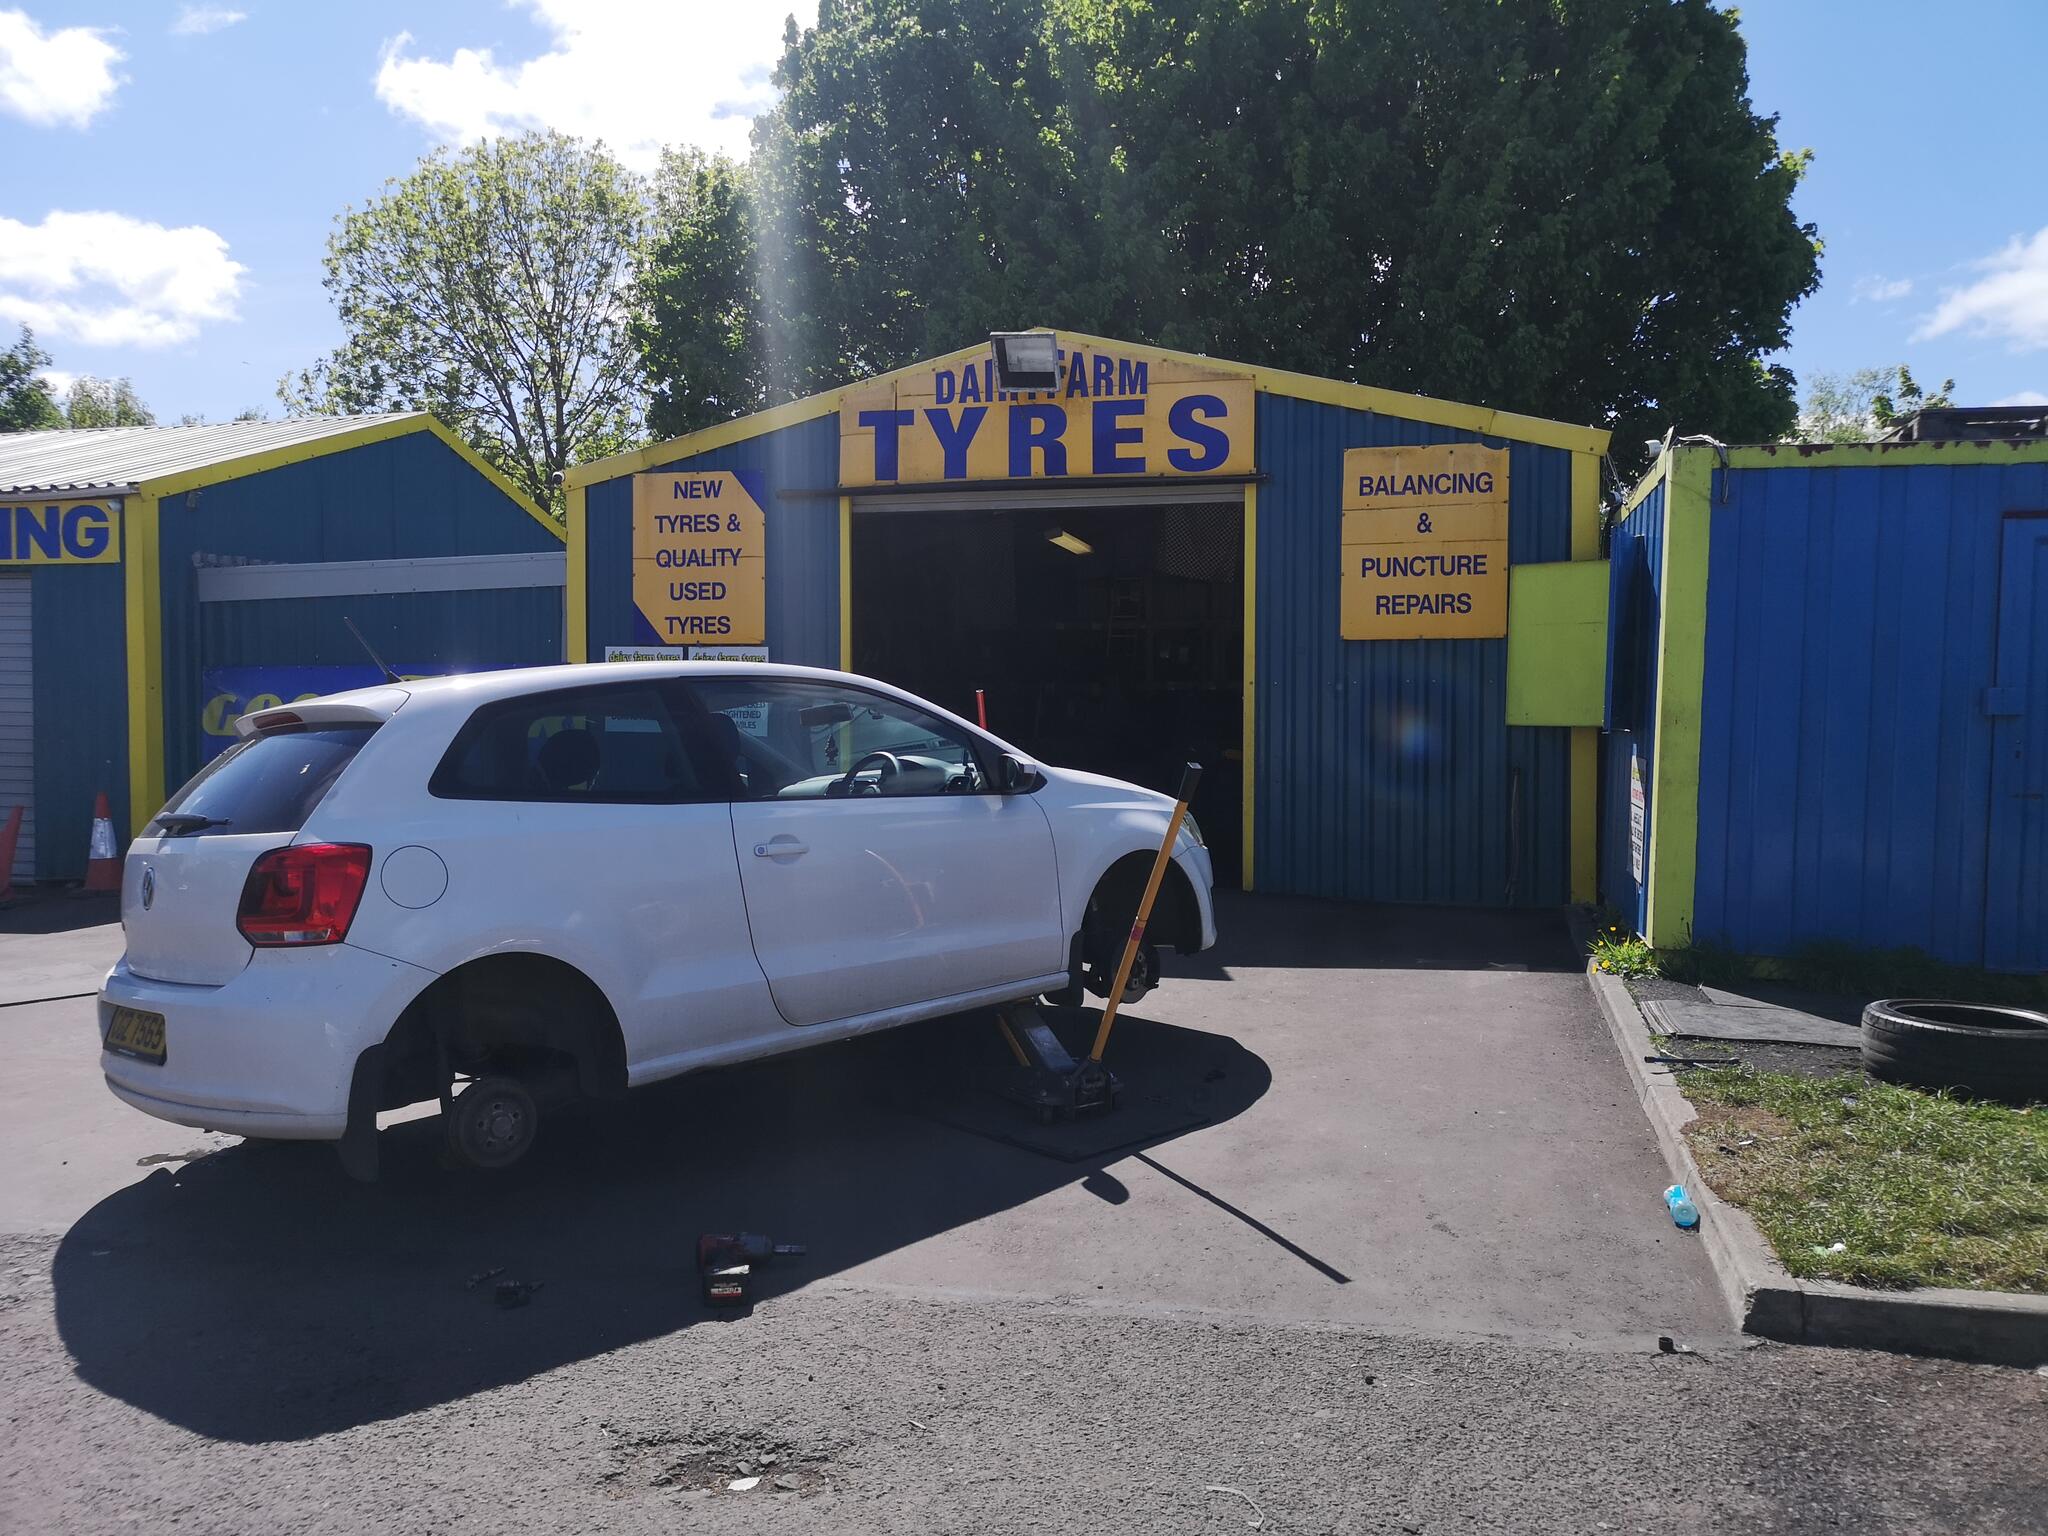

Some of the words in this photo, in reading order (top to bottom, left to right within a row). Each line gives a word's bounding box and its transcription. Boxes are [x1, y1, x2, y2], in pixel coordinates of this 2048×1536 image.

[936, 358, 1036, 405] DAI
[858, 394, 1230, 481] TYRES
[674, 480, 723, 499] NEW
[1359, 472, 1493, 496] BALANCING
[0, 505, 109, 559] ING
[655, 514, 720, 533] TYRES
[727, 513, 741, 532] &
[1417, 512, 1432, 533] &
[656, 548, 742, 568] QUALITY
[1361, 554, 1488, 578] PUNCTURE
[670, 582, 726, 601] USED
[1376, 593, 1472, 615] REPAIRS
[665, 616, 730, 634] TYRES
